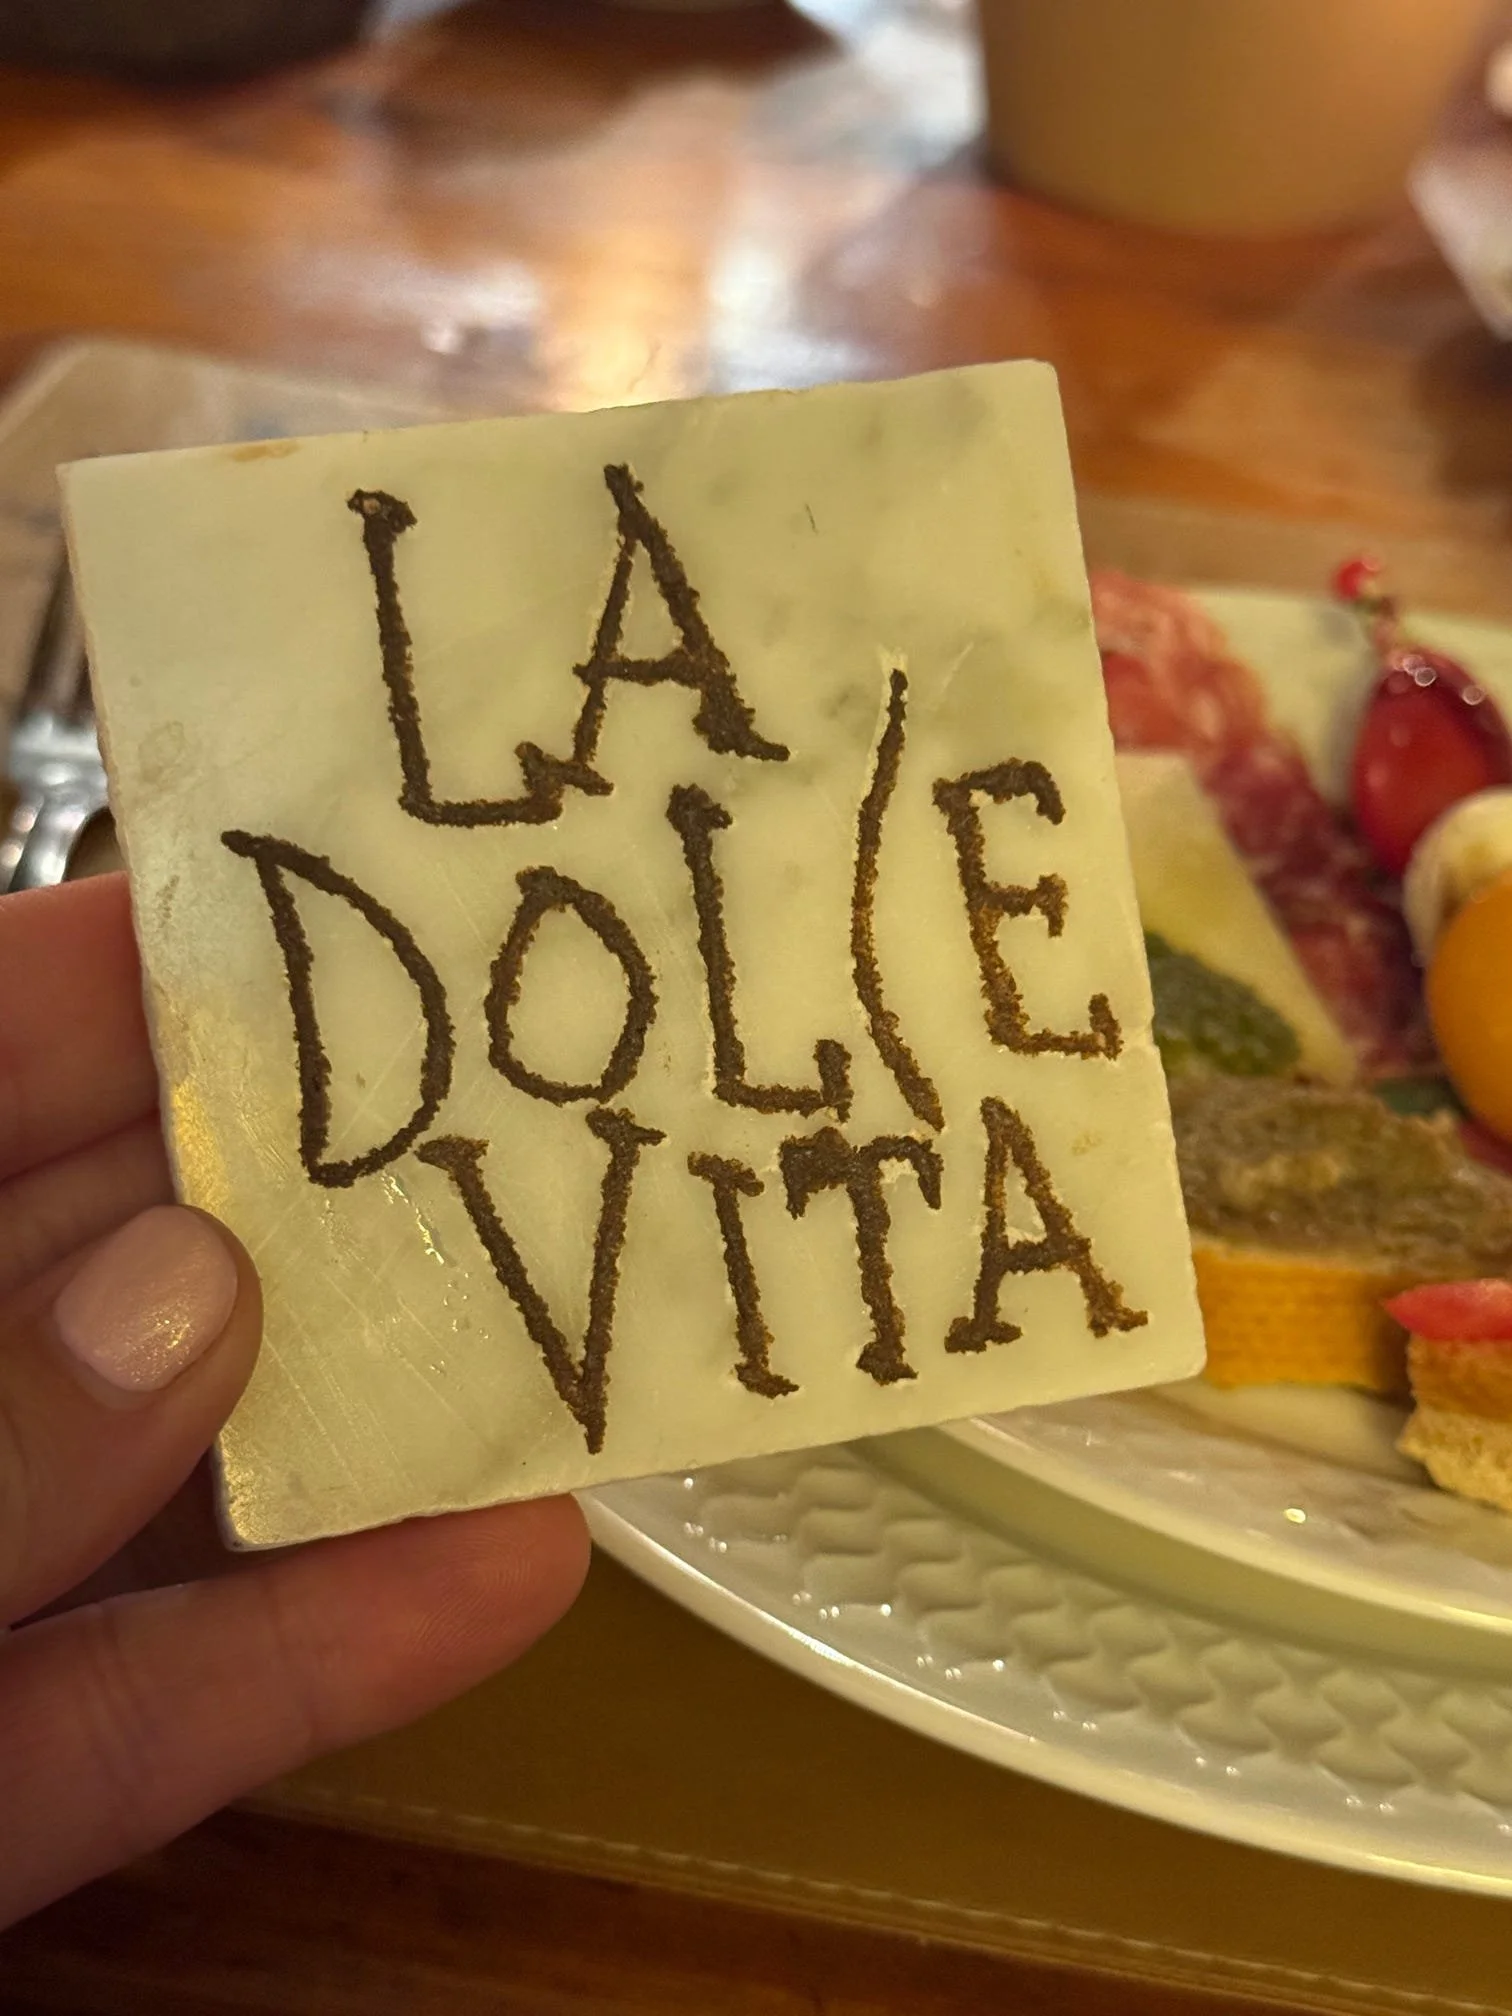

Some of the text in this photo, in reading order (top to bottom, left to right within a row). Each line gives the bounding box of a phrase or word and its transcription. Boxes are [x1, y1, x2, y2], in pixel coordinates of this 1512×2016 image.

[347, 463, 790, 829] LA
[221, 667, 1124, 1190] DOLCE
[413, 1096, 1148, 1456] VITA
